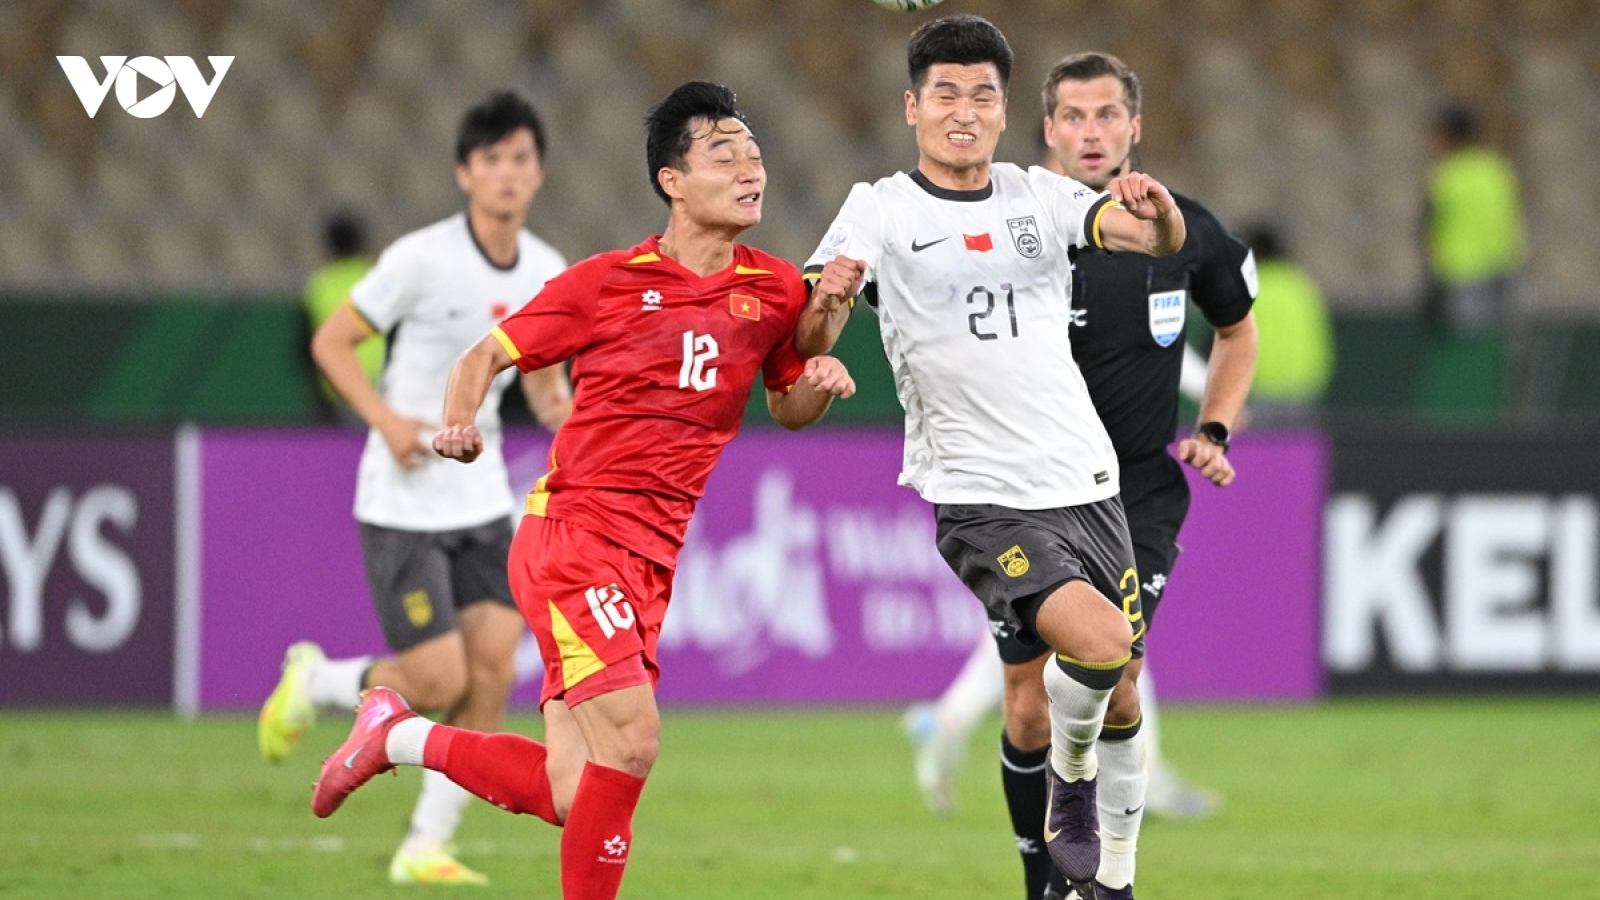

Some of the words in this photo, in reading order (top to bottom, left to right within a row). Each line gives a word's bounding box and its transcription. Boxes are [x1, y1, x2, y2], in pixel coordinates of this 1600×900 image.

[966, 282, 1018, 341] 21
[1153, 295, 1181, 311] FIFA
[678, 329, 720, 392] 12
[584, 583, 636, 640] 12
